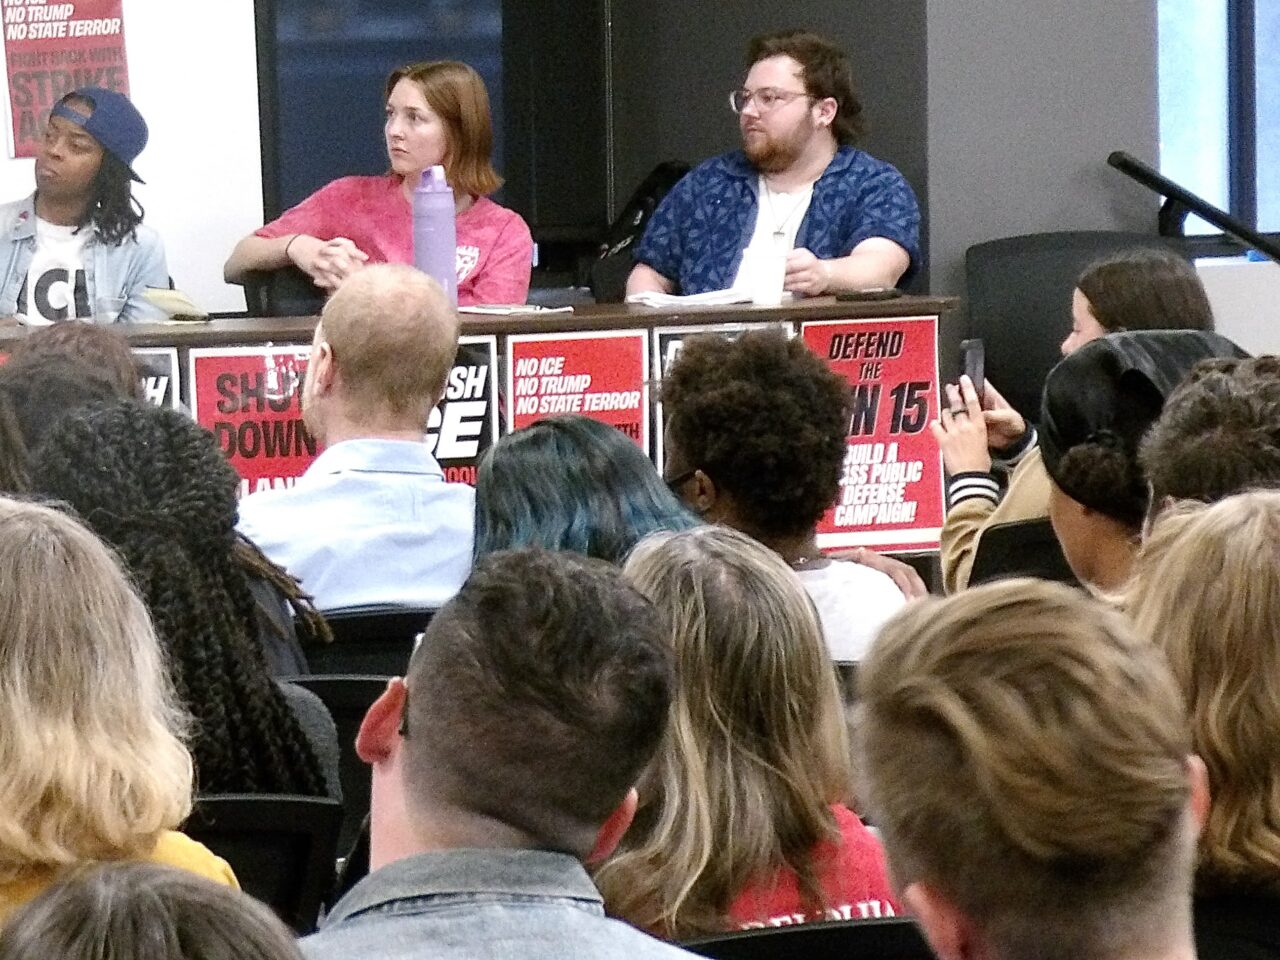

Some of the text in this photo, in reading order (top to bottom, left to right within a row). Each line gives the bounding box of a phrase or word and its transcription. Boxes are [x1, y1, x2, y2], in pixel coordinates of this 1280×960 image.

[5, 4, 74, 23] NO TRUMP
[7, 18, 120, 40] NO STATE TERROR
[829, 330, 904, 361] DEFEND
[515, 357, 565, 376] NO ICE
[858, 362, 883, 381] THE
[516, 375, 592, 396] NO TRUMP
[516, 391, 641, 414] NO STATE TERROR
[849, 381, 932, 437] N 15
[215, 420, 317, 459] DOWN
[886, 442, 899, 463] A
[839, 461, 923, 486] ASS PUBLIC
[843, 482, 906, 505] DEFENSE
[834, 501, 917, 527] CAMPAIGN!
